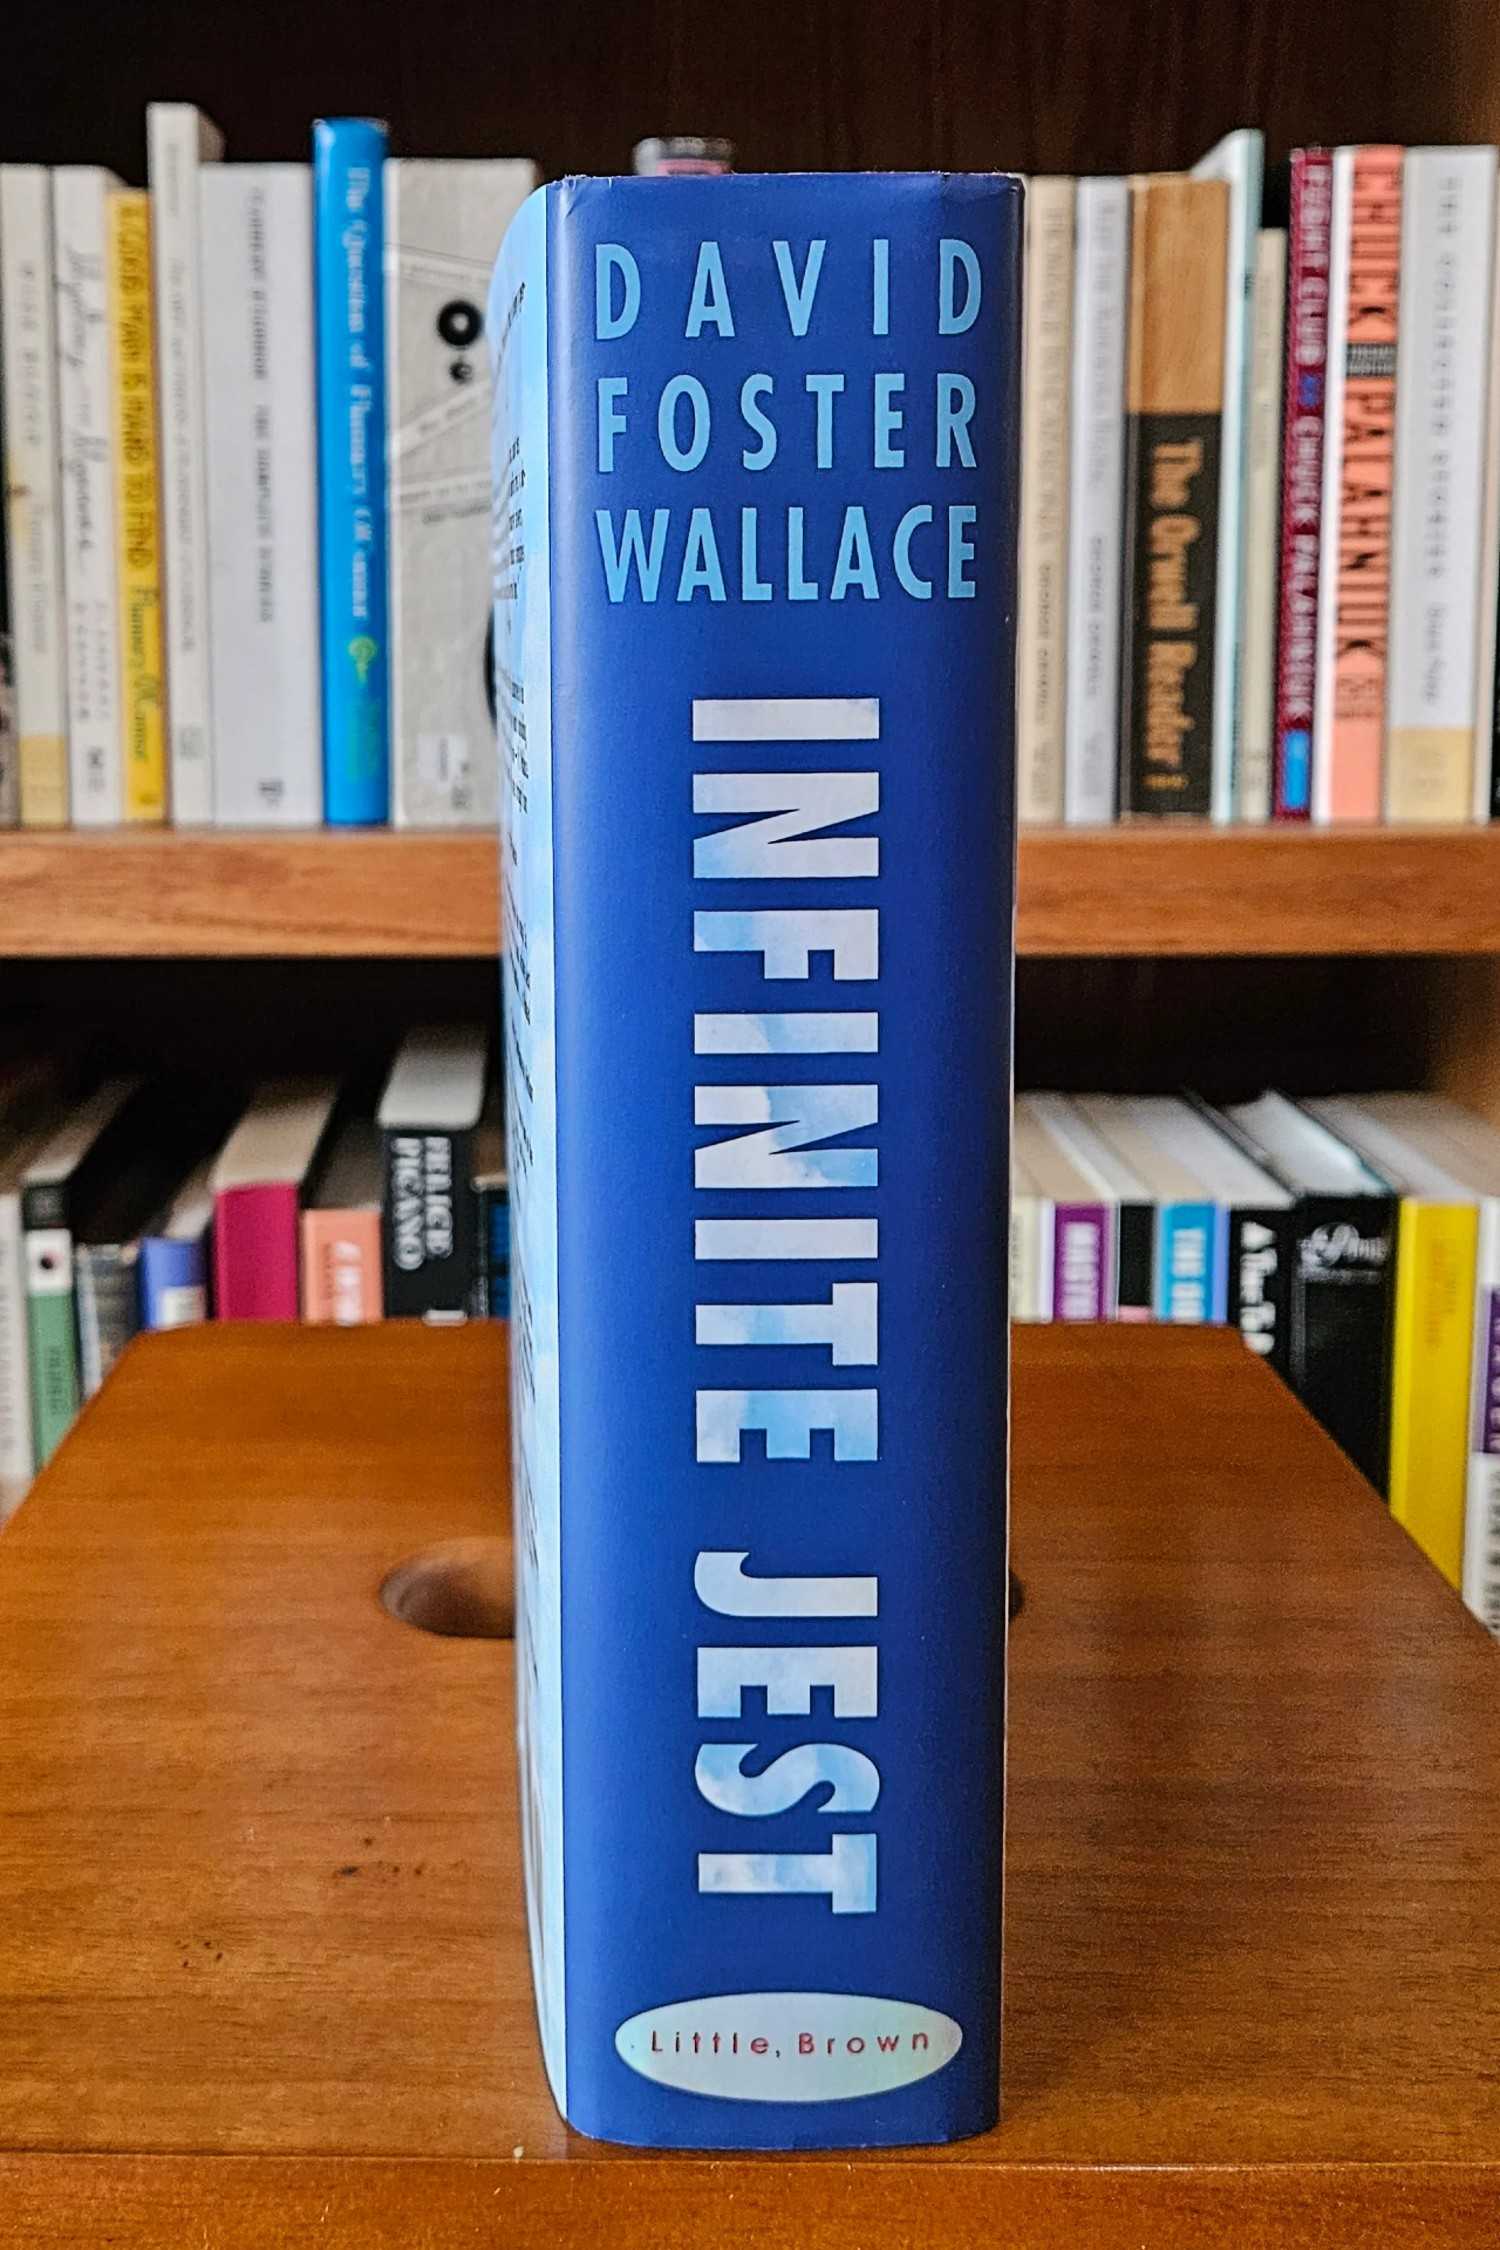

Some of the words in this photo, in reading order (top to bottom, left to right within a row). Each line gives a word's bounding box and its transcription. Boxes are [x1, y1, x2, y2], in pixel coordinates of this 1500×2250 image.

[1302, 165, 1330, 268] FIGHT
[1346, 166, 1400, 328] CHUCK
[595, 239, 982, 340] DAVID
[1297, 277, 1327, 366] CLUB
[598, 373, 977, 473] FOSTER
[1149, 439, 1202, 510] The
[1291, 416, 1322, 528] CHUCK
[595, 504, 977, 603] WALLACE
[1147, 514, 1200, 634] Orwell
[1337, 390, 1397, 660] PALAHNIUK
[1288, 535, 1321, 719] PALAHNIUK
[1143, 640, 1197, 768] Reader
[693, 698, 879, 1462] INFINITE
[390, 1138, 425, 1270] PICANO
[425, 1137, 453, 1259] FELICE
[694, 1551, 880, 1913] JEST
[651, 2031, 782, 2057] Little,
[798, 2030, 930, 2055] Brown
